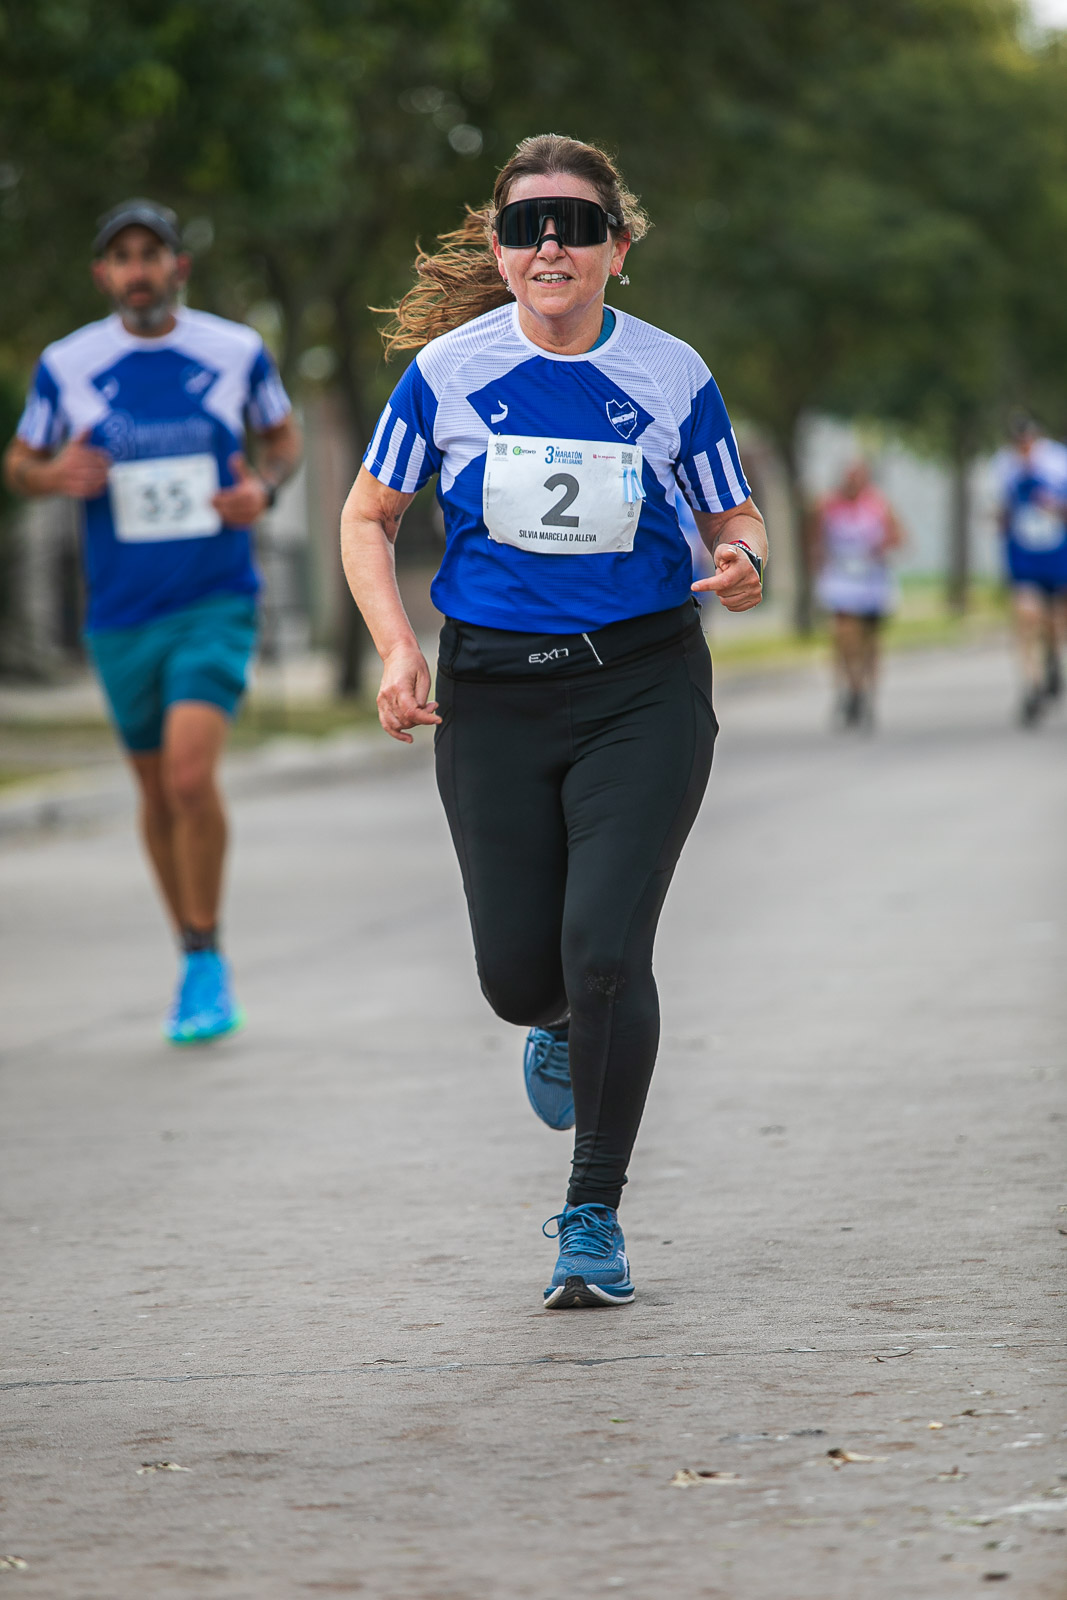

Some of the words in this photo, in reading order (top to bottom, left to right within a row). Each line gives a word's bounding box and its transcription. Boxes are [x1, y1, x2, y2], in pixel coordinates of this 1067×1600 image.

[544, 446, 555, 464] 3
[555, 450, 583, 460] MARATÓN
[541, 472, 580, 528] 2
[519, 529, 538, 540] SILVIA
[539, 531, 568, 542] MARCELA
[569, 533, 574, 542] D
[575, 533, 597, 543] ALLEVA
